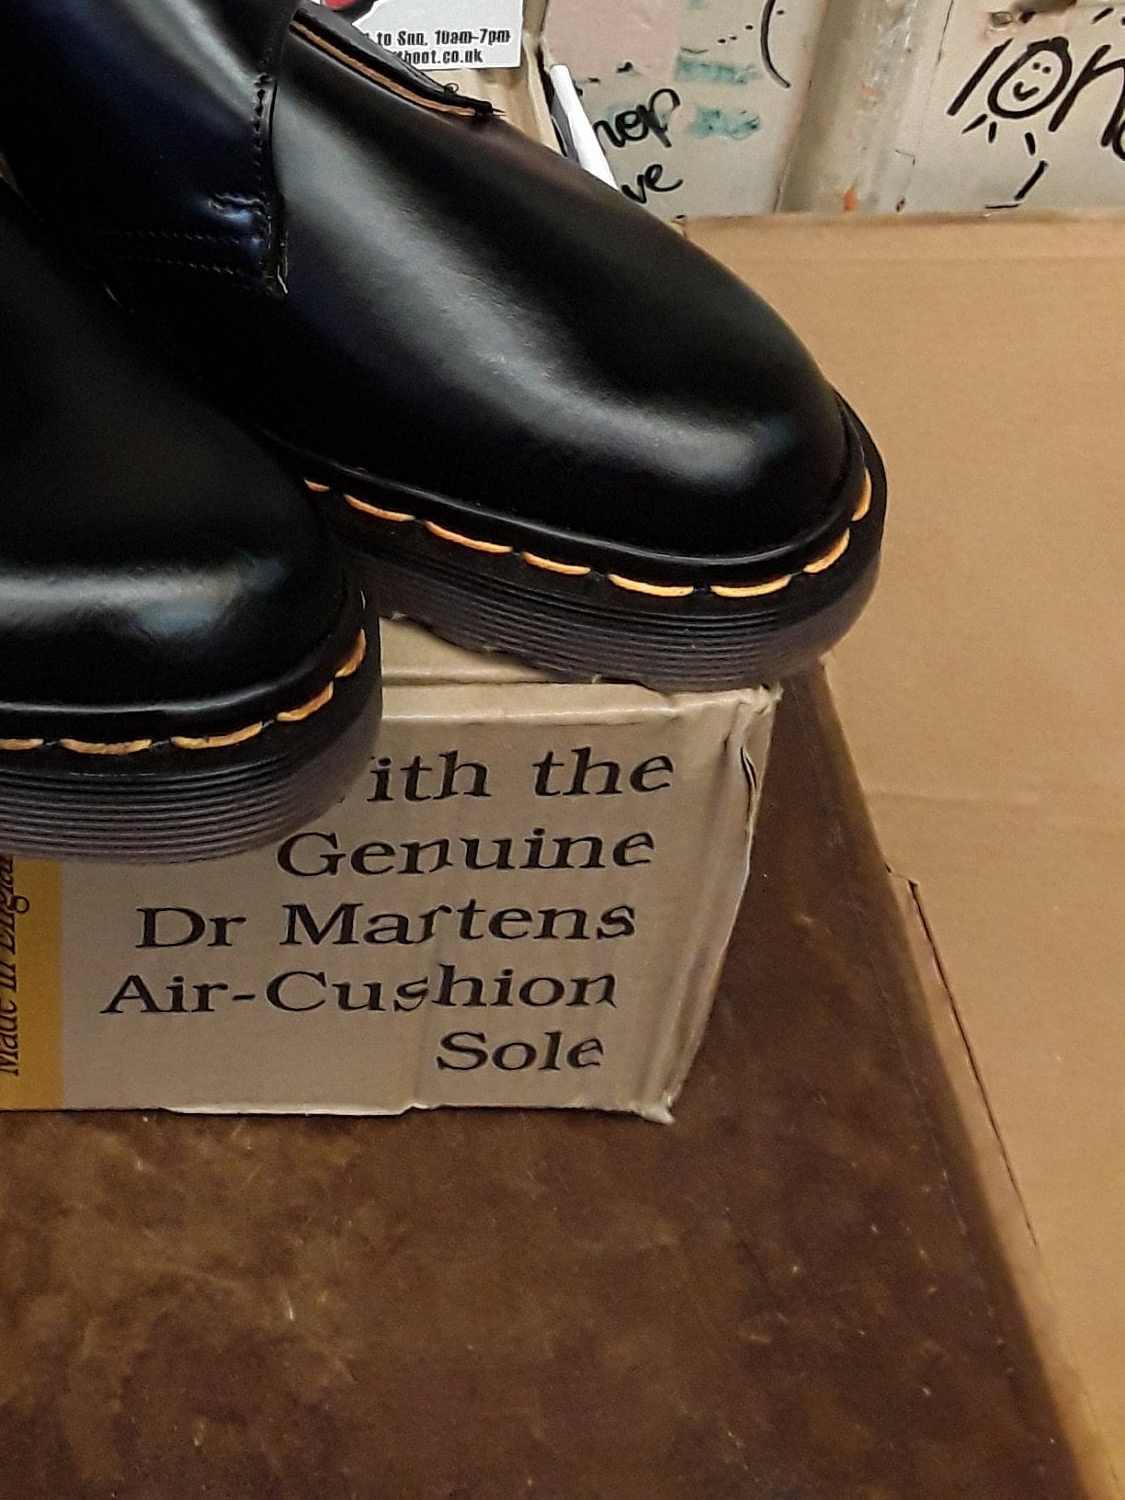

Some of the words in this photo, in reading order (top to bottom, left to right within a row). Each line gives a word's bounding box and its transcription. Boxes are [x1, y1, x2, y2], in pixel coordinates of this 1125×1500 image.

[337, 746, 492, 803] ith
[532, 746, 674, 798] the
[278, 827, 655, 877] Genuine
[135, 906, 246, 949] Dr
[280, 899, 636, 946] Martens
[99, 963, 618, 1015] Air-Cushion
[436, 1030, 605, 1071] Sole
